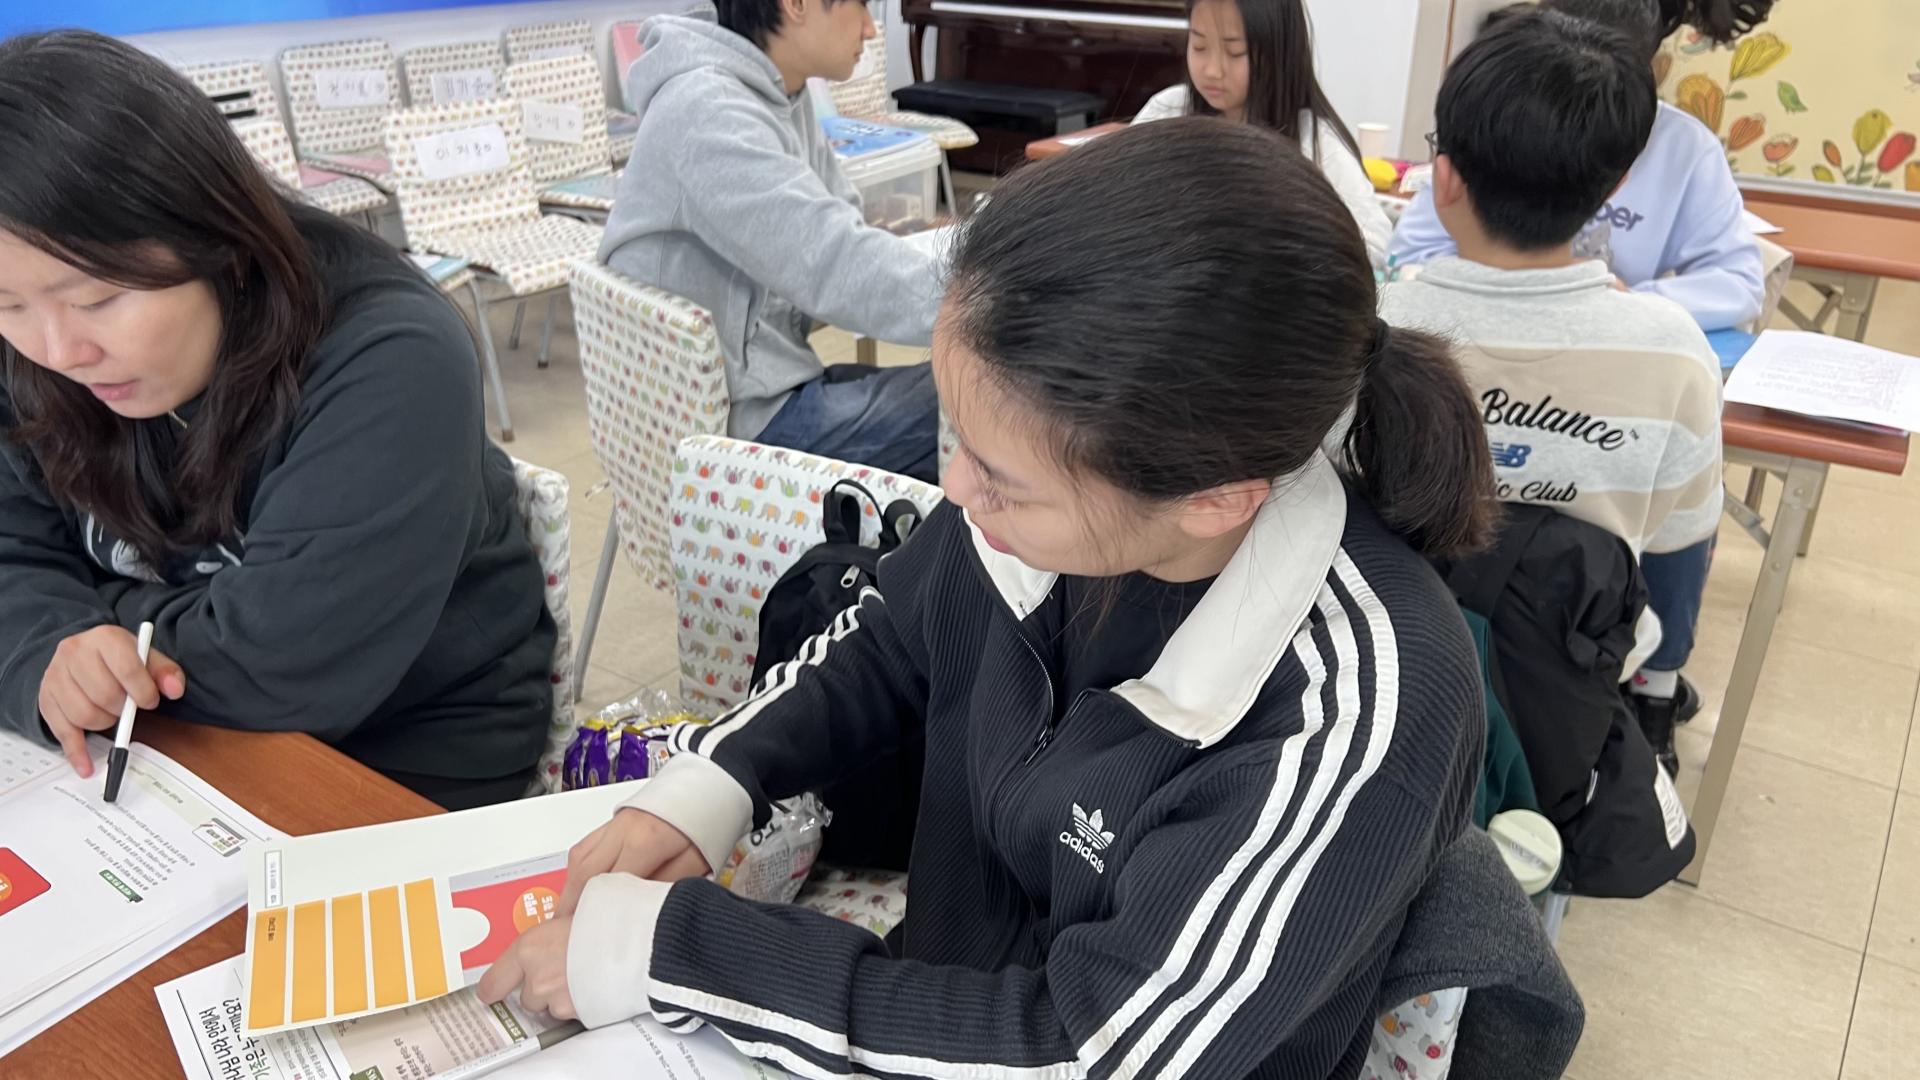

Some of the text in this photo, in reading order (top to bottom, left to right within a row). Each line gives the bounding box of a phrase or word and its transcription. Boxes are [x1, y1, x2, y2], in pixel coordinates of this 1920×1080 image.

[1481, 388, 1626, 451] Balance
[1520, 480, 1577, 502] Club
[1060, 831, 1104, 874] adidas
[199, 1006, 227, 1038] 안에서
[211, 1036, 233, 1060] 나라
